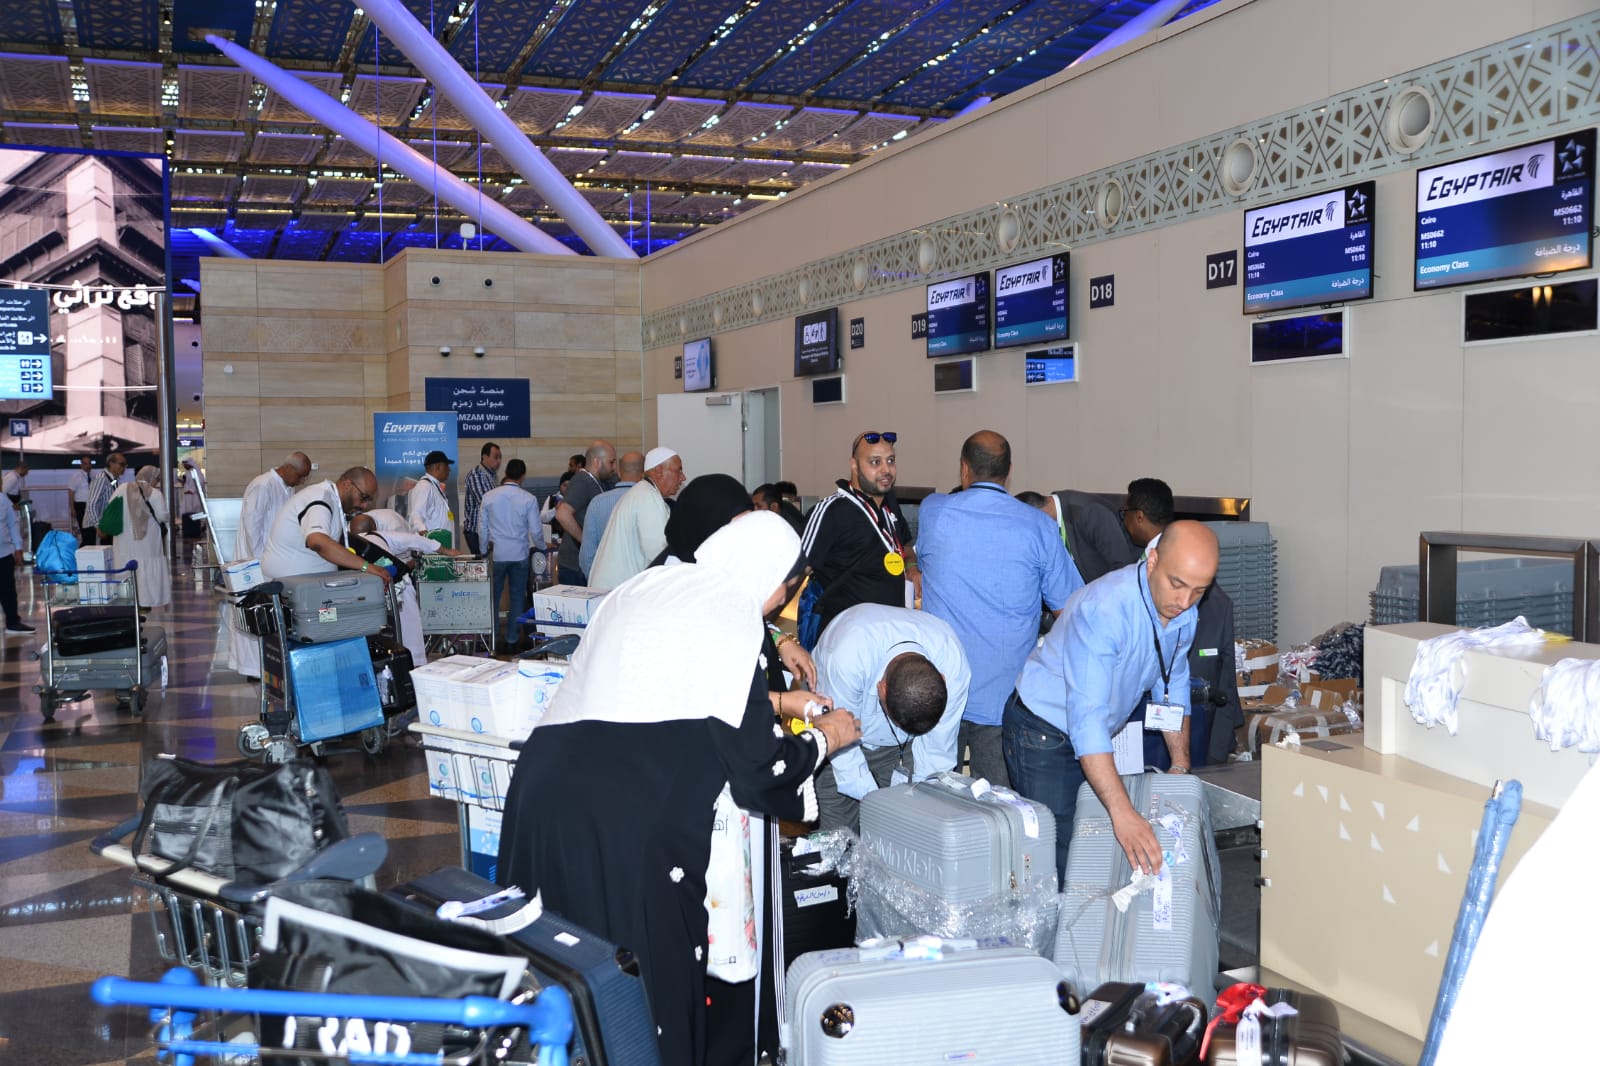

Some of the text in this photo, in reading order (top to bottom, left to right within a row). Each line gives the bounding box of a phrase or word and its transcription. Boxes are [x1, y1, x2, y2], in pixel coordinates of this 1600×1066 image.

[1426, 163, 1525, 201] EGYPTAIR
[1251, 208, 1323, 238] EGYPTAIR
[1421, 216, 1437, 225] Cairo
[1562, 215, 1583, 225] 11:10
[1421, 241, 1437, 249] 11:10
[1208, 260, 1235, 281] D17
[1420, 260, 1469, 275] Economy Class
[999, 271, 1041, 291] EGYPTAIR
[53, 280, 114, 314] تراثي
[930, 287, 965, 305] EGYPTAIR
[1091, 285, 1113, 301] D18
[851, 323, 864, 336] D20
[912, 319, 927, 333] D19
[453, 385, 505, 396] منصة شحن
[452, 398, 504, 410] عبوات زمزم
[457, 414, 509, 422] MZAM Water
[382, 422, 436, 433] EGYPTAIR
[462, 423, 495, 432] Drop Off
[902, 846, 944, 884] Klein
